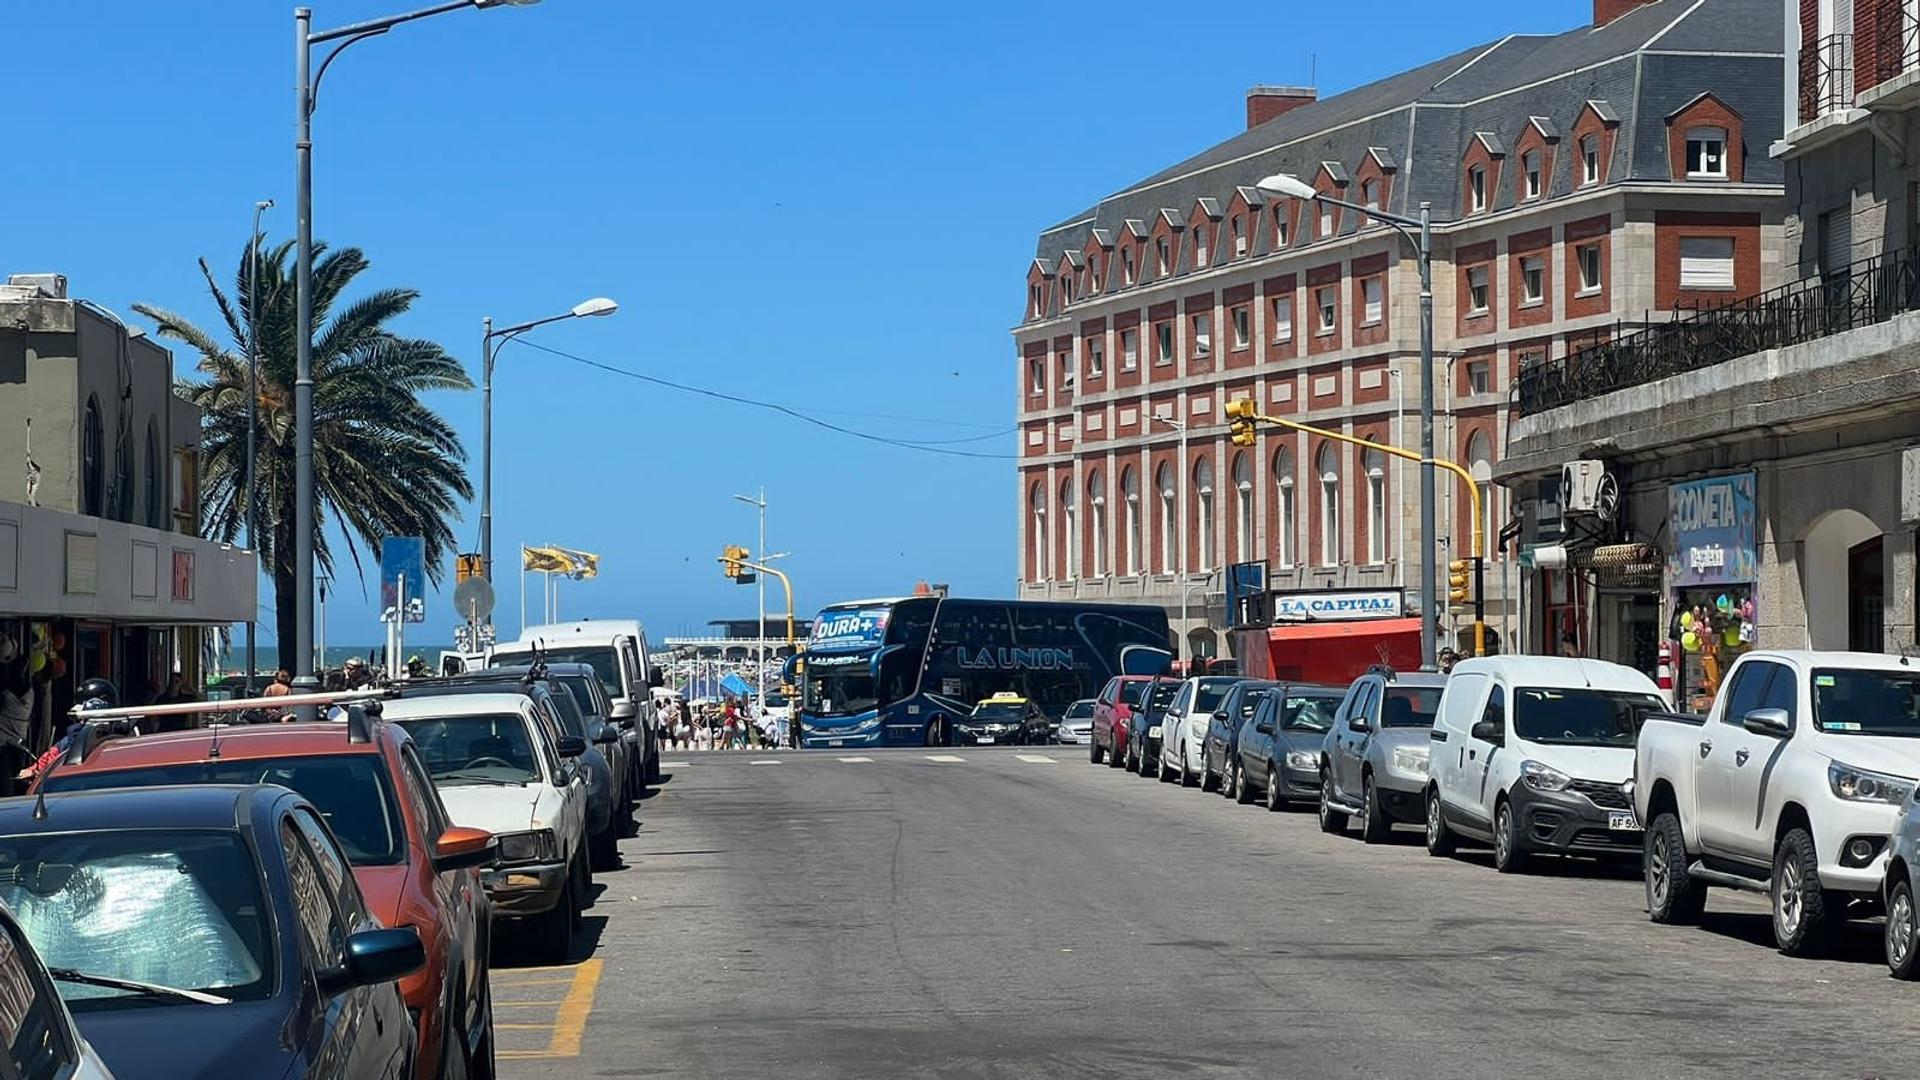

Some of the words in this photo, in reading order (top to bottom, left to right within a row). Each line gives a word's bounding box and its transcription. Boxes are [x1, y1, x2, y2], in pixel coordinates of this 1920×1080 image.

[1681, 483, 1736, 531] COMETA
[1281, 601, 1306, 613] LA
[1311, 598, 1394, 611] CAPITAL
[817, 617, 873, 639] DURA+
[957, 646, 996, 669] LA
[998, 647, 1073, 670] UNION
